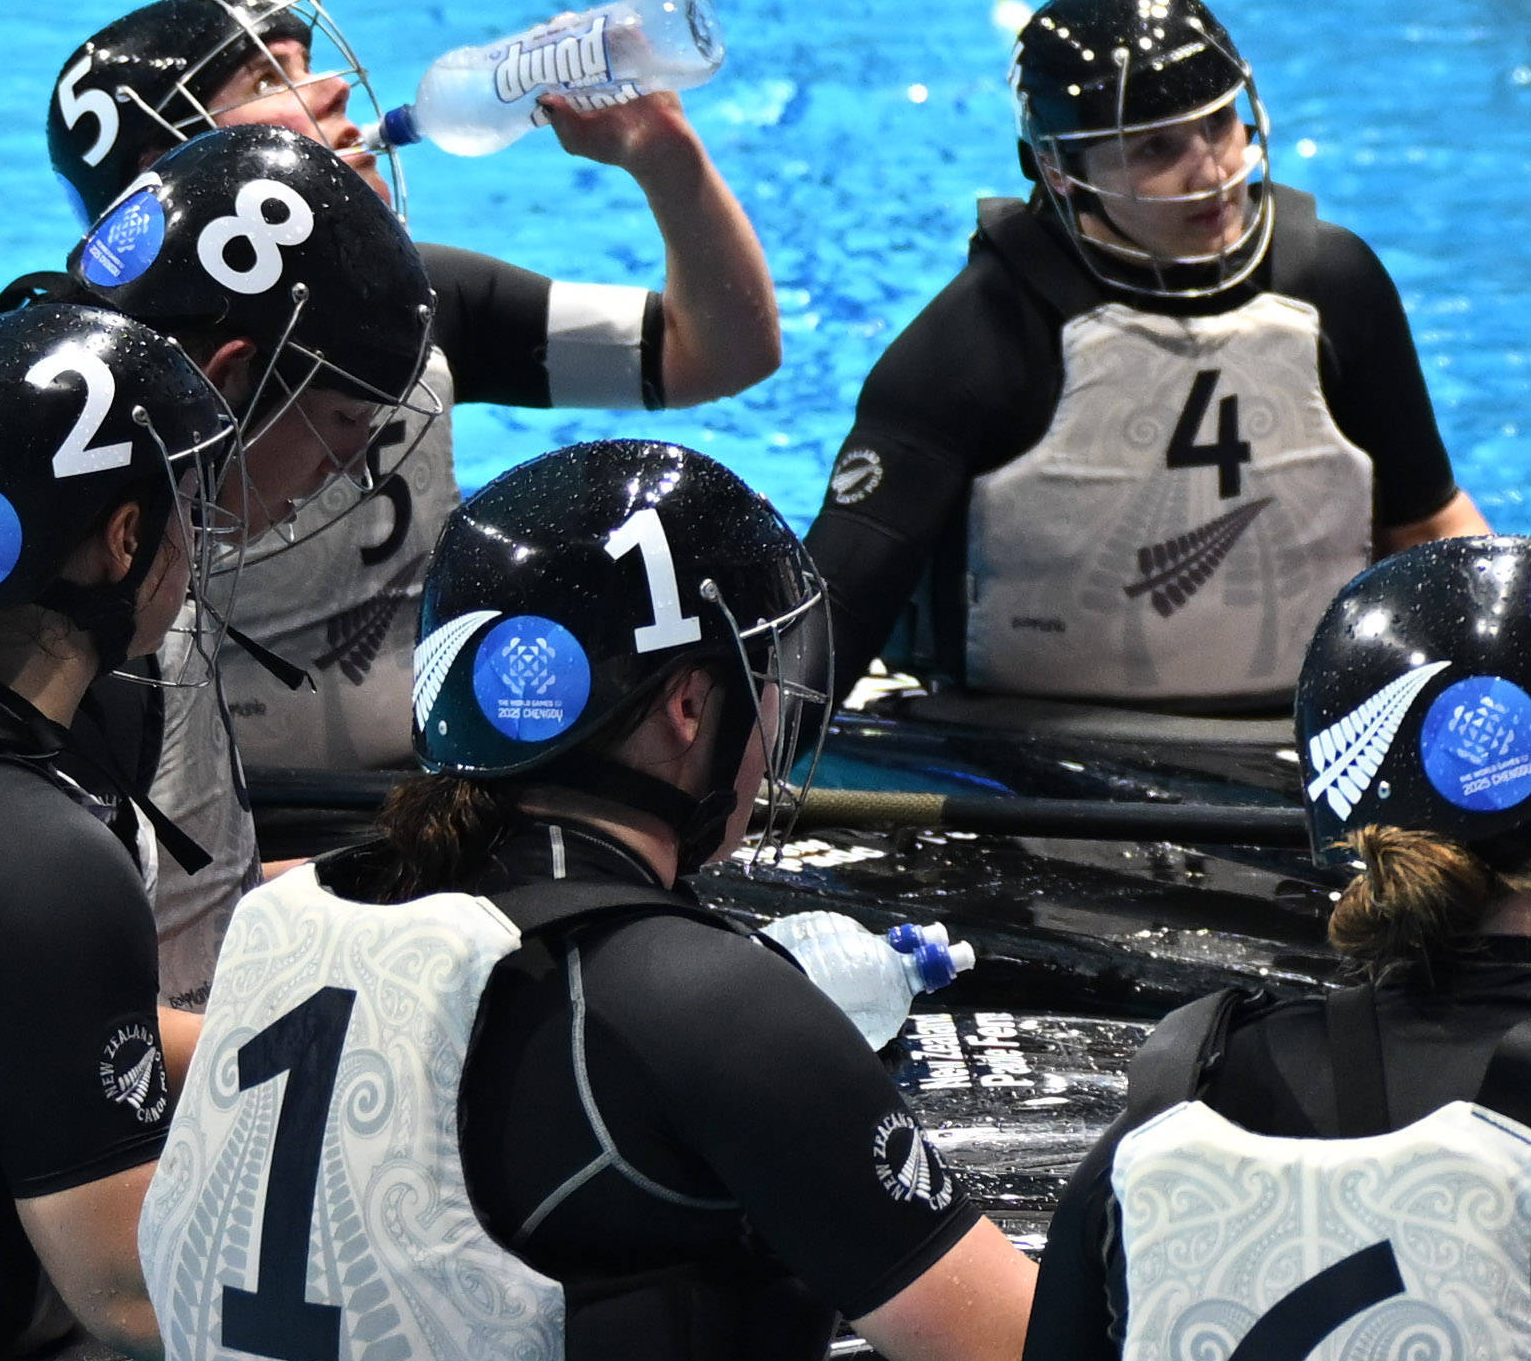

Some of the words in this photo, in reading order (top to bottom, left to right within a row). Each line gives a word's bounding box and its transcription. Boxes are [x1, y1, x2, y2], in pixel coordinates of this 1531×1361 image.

[495, 15, 609, 103] pump
[58, 52, 120, 166] 5
[195, 178, 314, 295] 8
[25, 343, 133, 478] 2
[1167, 369, 1251, 498] 4
[603, 507, 702, 653] 1
[498, 707, 521, 719] 2025
[99, 1061, 120, 1099] NEW
[103, 1024, 154, 1059] ZEALAND
[919, 1060, 972, 1090] New
[875, 1163, 904, 1201] NEW
